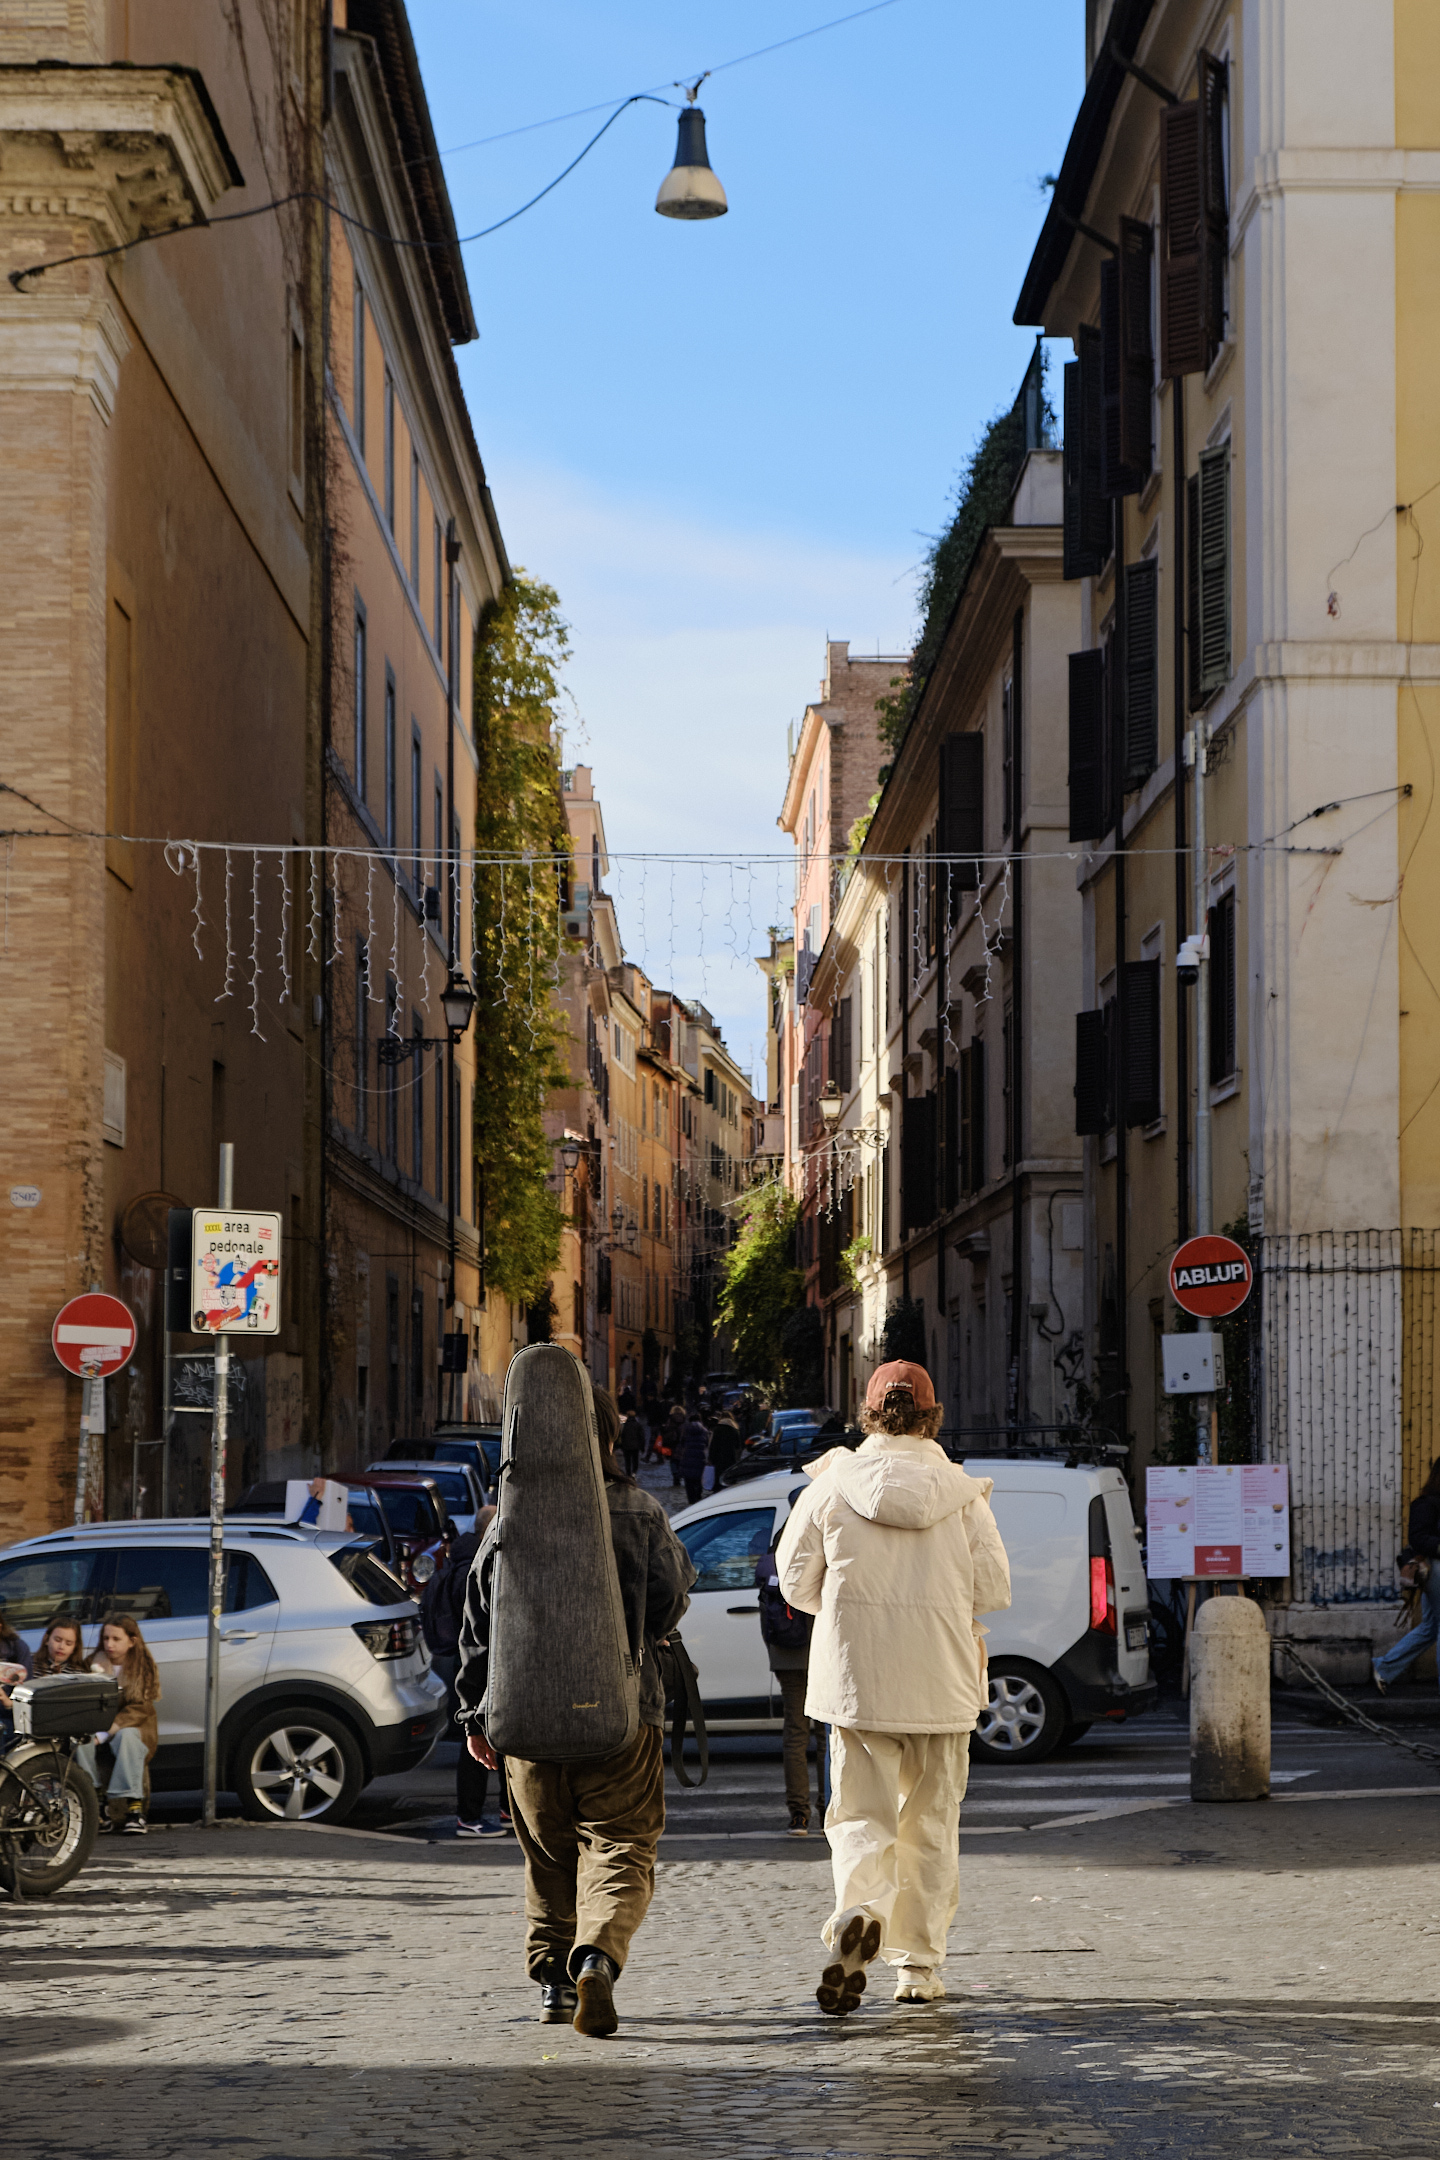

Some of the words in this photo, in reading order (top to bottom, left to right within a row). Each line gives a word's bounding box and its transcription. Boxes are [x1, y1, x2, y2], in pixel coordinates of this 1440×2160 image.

[224, 1222, 250, 1233] area
[210, 1240, 264, 1254] pedonale
[1178, 1263, 1244, 1287] ABLUP
